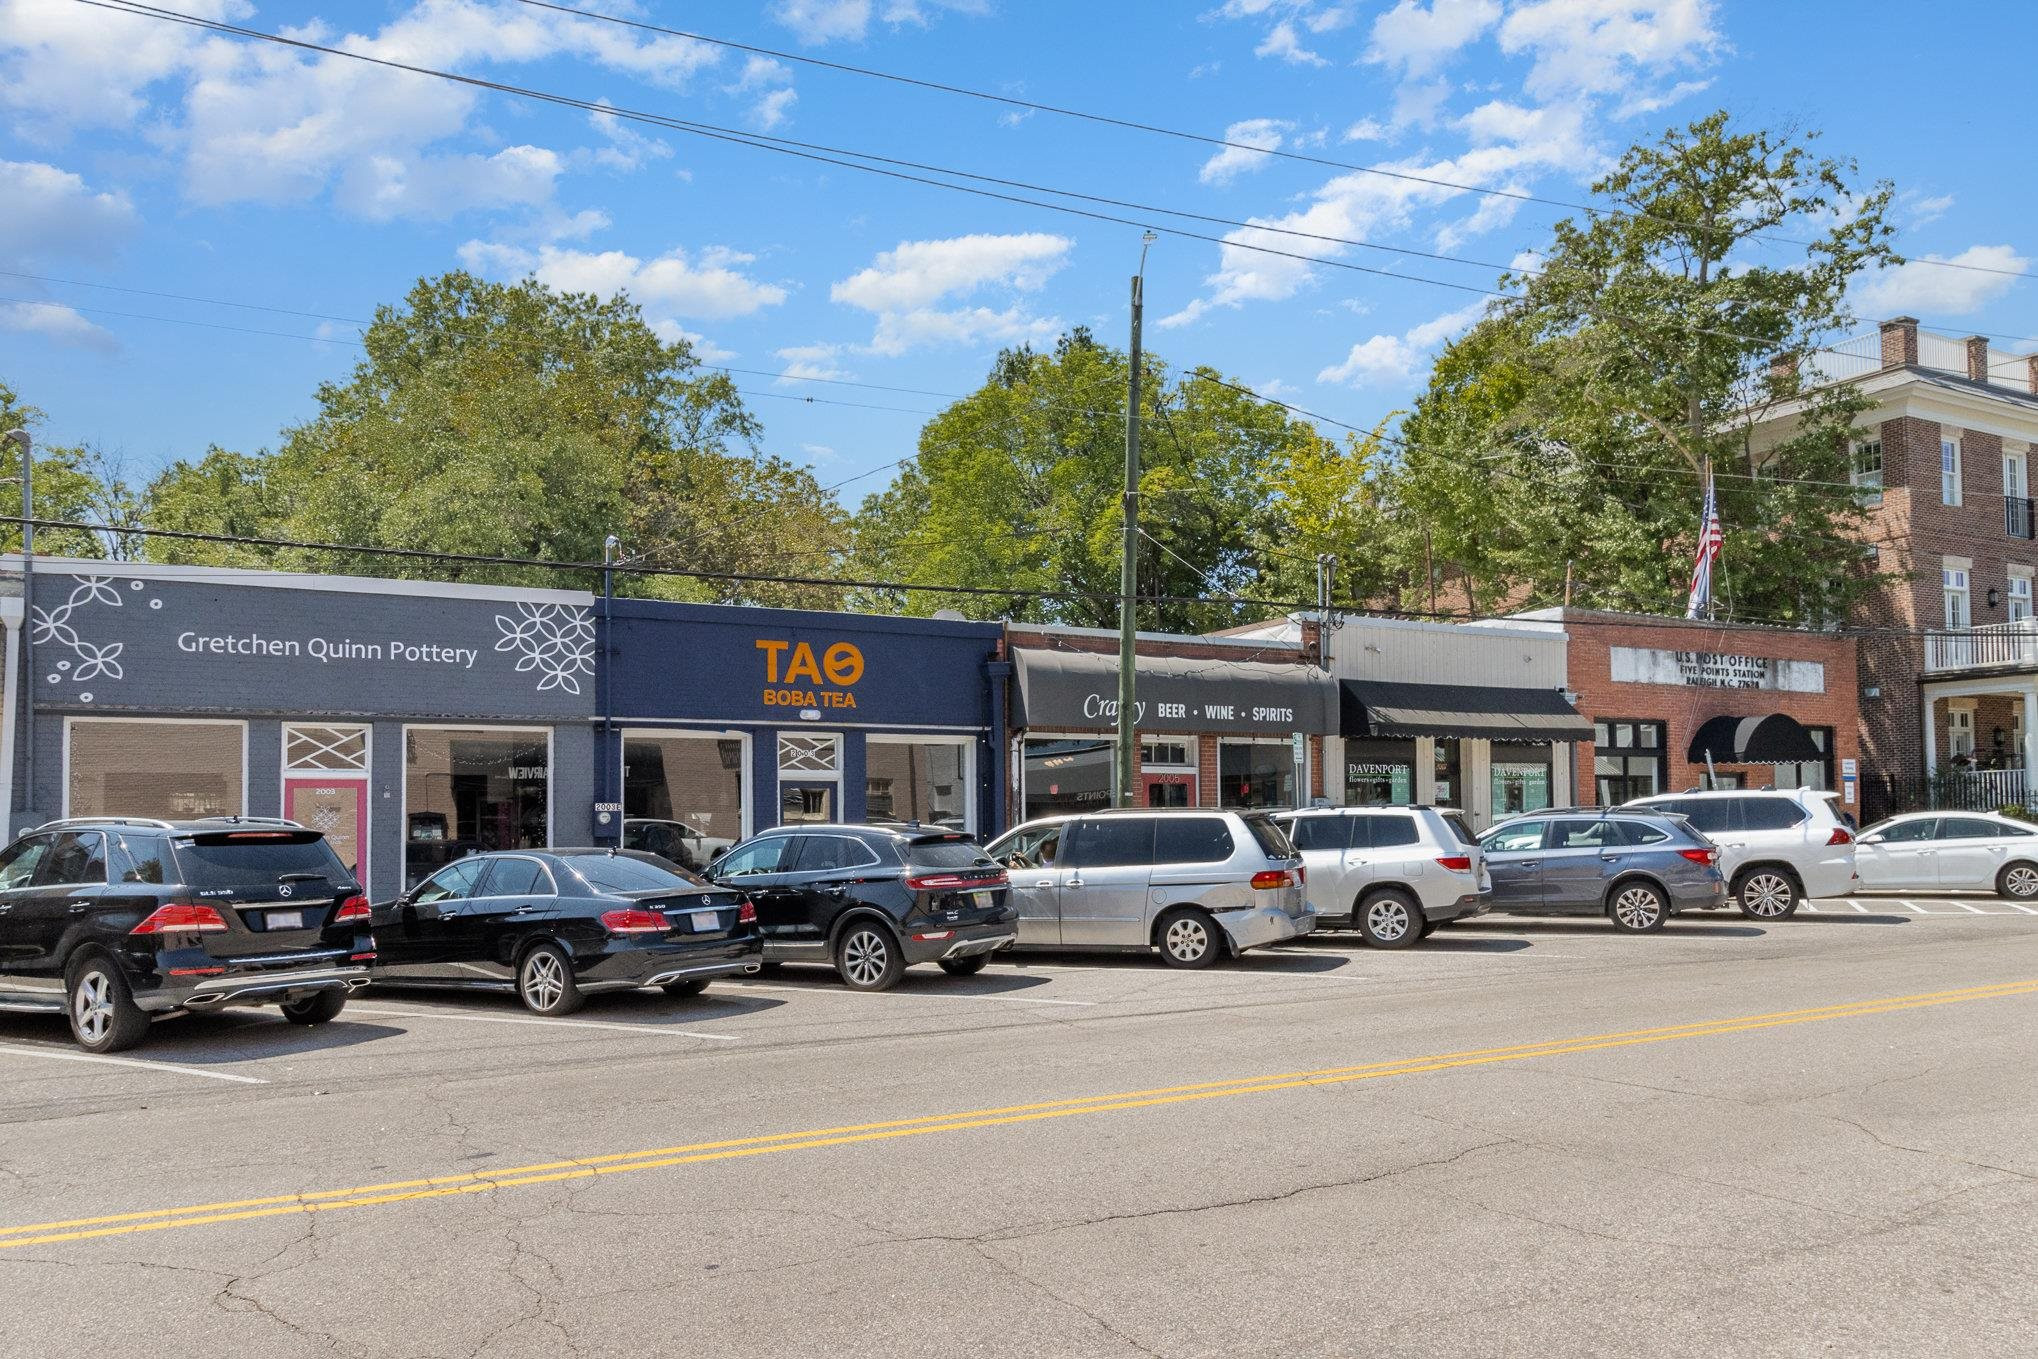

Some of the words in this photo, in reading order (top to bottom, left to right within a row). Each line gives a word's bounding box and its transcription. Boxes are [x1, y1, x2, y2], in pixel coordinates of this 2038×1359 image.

[178, 632, 300, 656] Gretchen
[307, 638, 382, 663] Quinn
[390, 642, 478, 669] Pottery
[756, 640, 864, 686] TAO
[1676, 651, 1693, 663] U.S.
[1728, 656, 1768, 669] OFFICE
[1680, 665, 1697, 675] FIVE
[1701, 667, 1730, 677] POINTS
[1733, 669, 1765, 679] STATION
[1686, 677, 1717, 687] RALEIGH
[763, 689, 817, 707] BOBA
[820, 691, 857, 709] TEA
[1083, 693, 1146, 726] Cray
[1158, 702, 1186, 718] BEER
[1205, 705, 1235, 720] WINE
[1252, 707, 1293, 722] SPIRITS
[1349, 764, 1408, 775] DAVENPORT
[1494, 768, 1546, 777] DAVENPORT
[1158, 774, 1180, 783] 2005
[1388, 776, 1408, 784] garden
